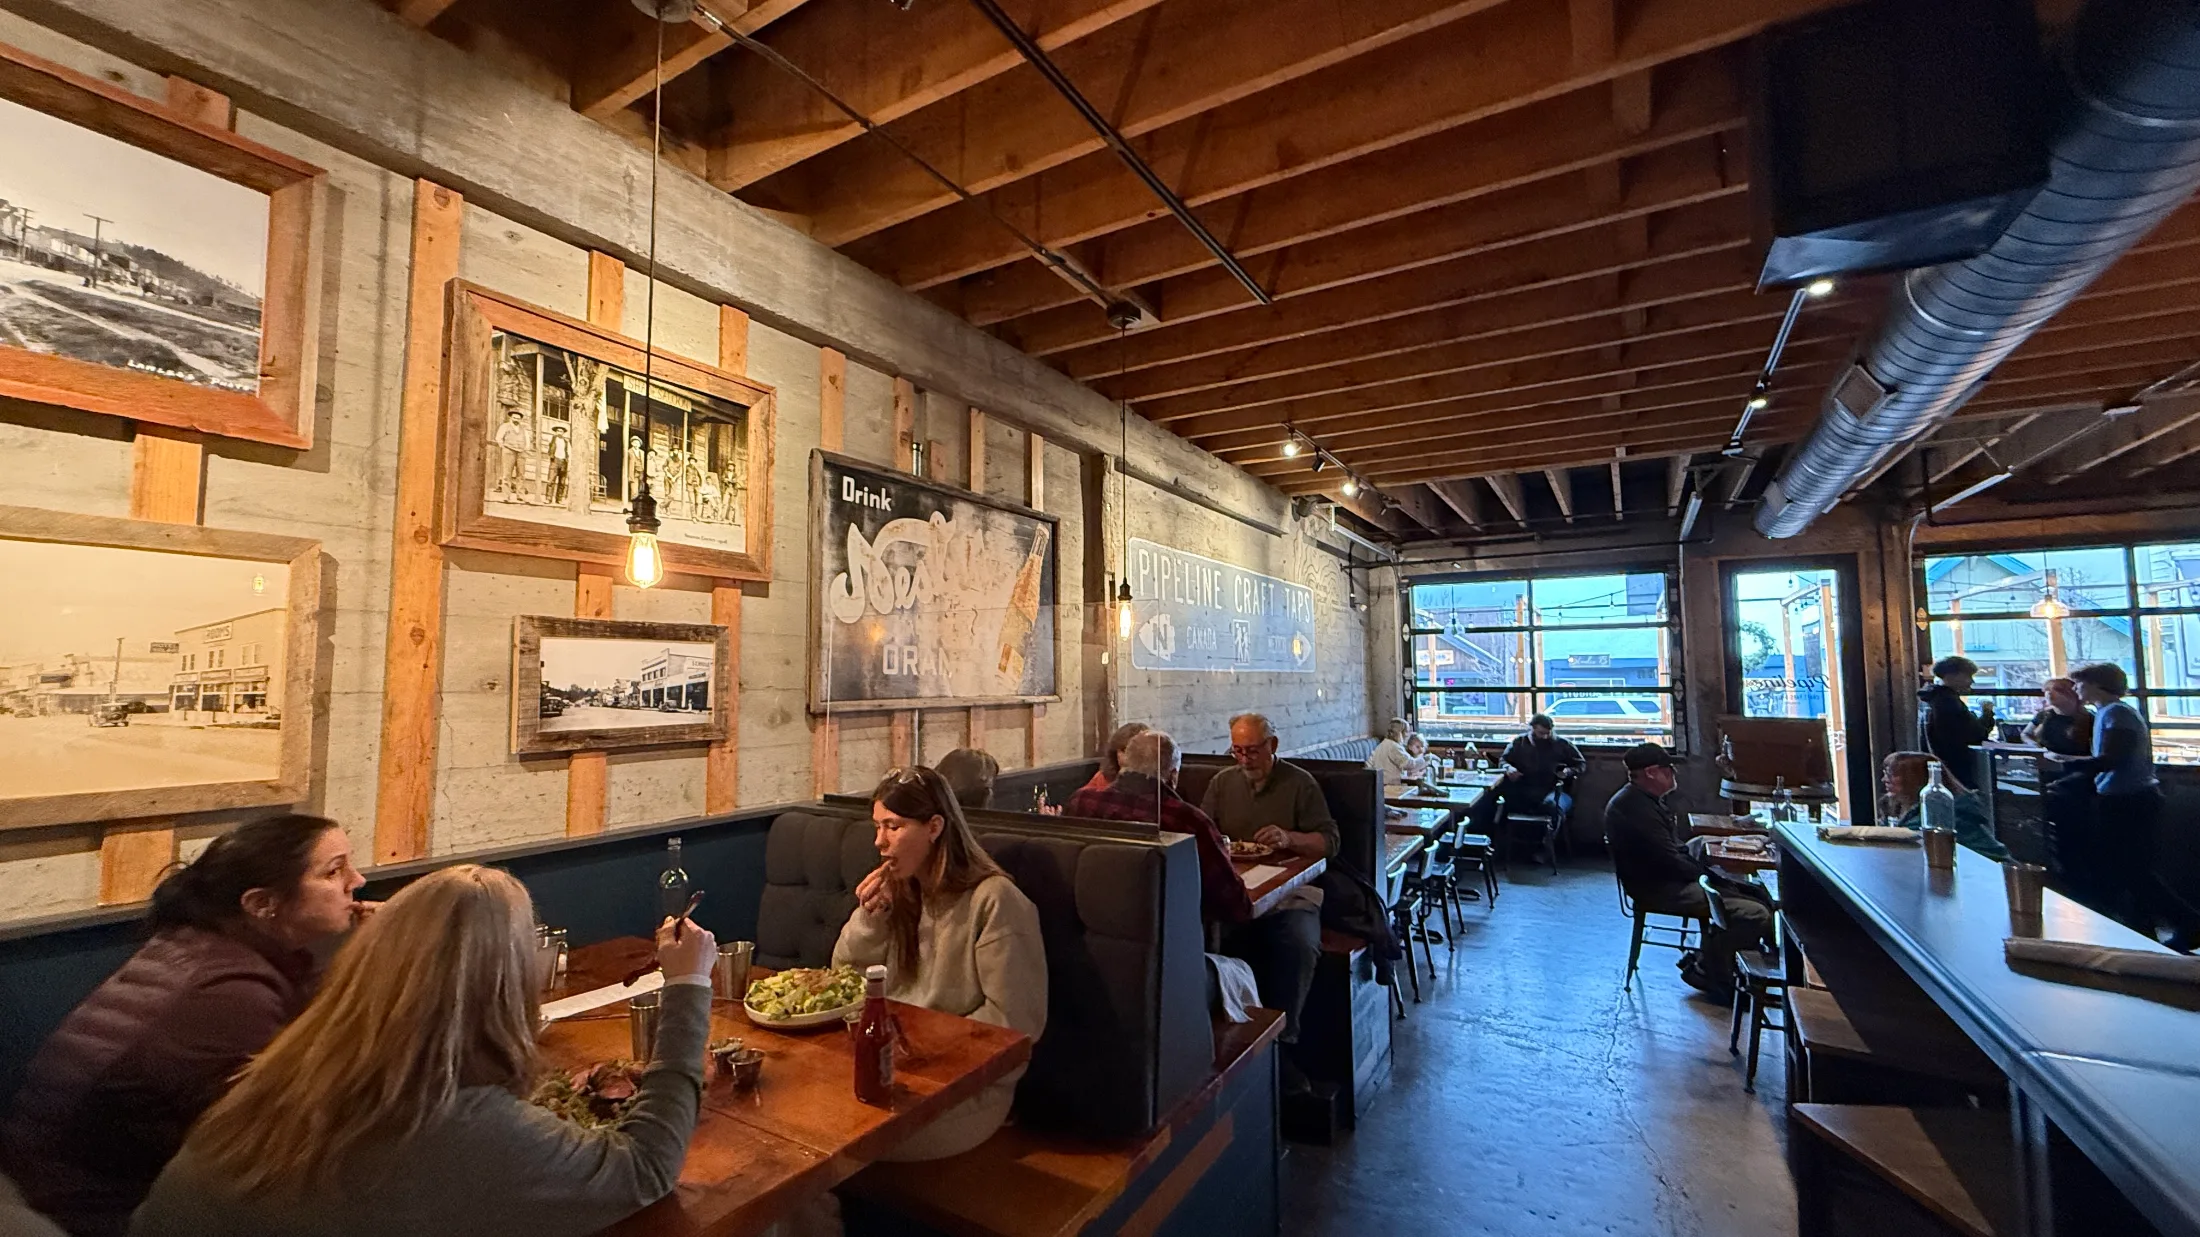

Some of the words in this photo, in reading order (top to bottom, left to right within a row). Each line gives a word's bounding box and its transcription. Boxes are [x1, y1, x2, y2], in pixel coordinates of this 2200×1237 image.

[842, 475, 892, 511] Drink
[1139, 548, 1222, 610] PIPELINE
[1234, 574, 1274, 616] CRAFT
[1284, 587, 1311, 623] TAPS
[1152, 622, 1168, 650] N
[1186, 626, 1217, 649] CANADA
